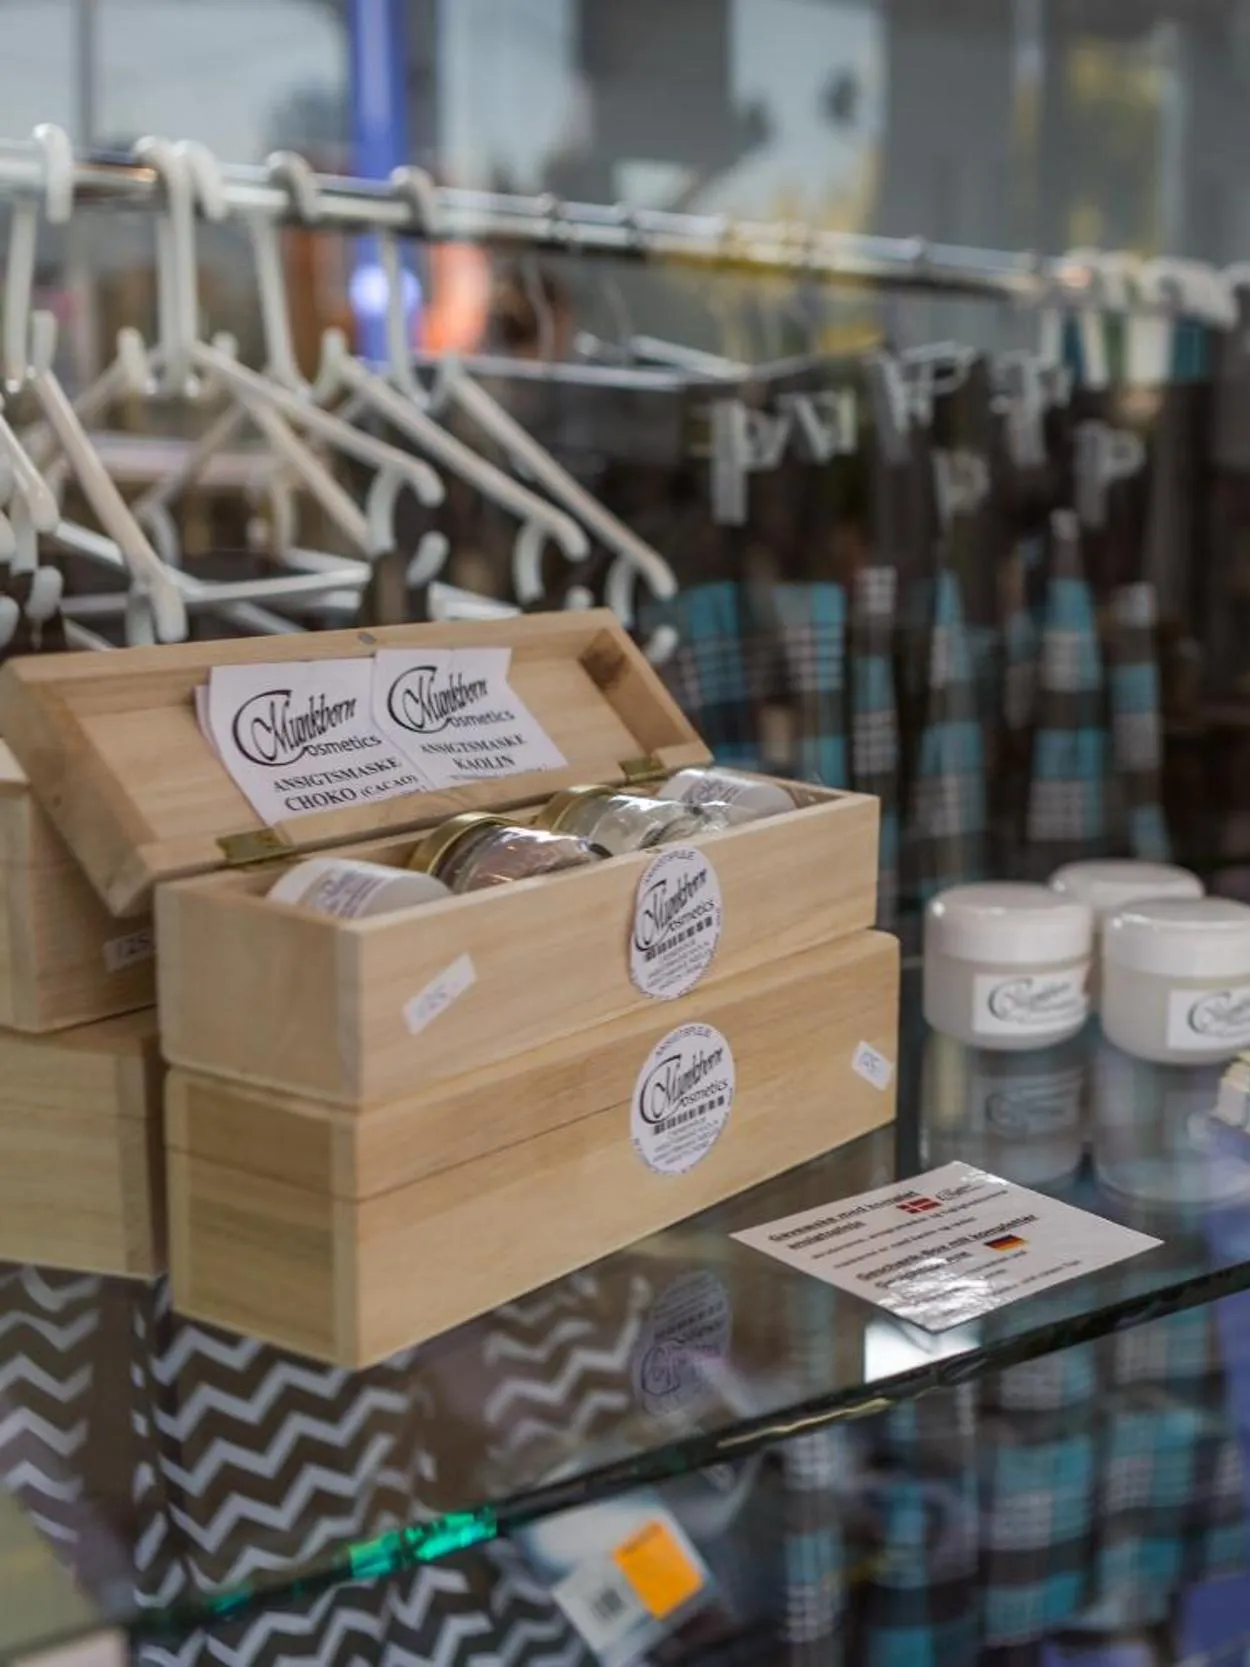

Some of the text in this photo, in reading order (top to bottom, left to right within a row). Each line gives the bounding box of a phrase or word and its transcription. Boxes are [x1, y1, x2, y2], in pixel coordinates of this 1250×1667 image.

[420, 734, 526, 754] ANSIGTSMASKE
[452, 755, 516, 771] KAOLIN
[273, 757, 401, 792] ANSIGTSMASKE
[285, 788, 357, 811] CHOKO
